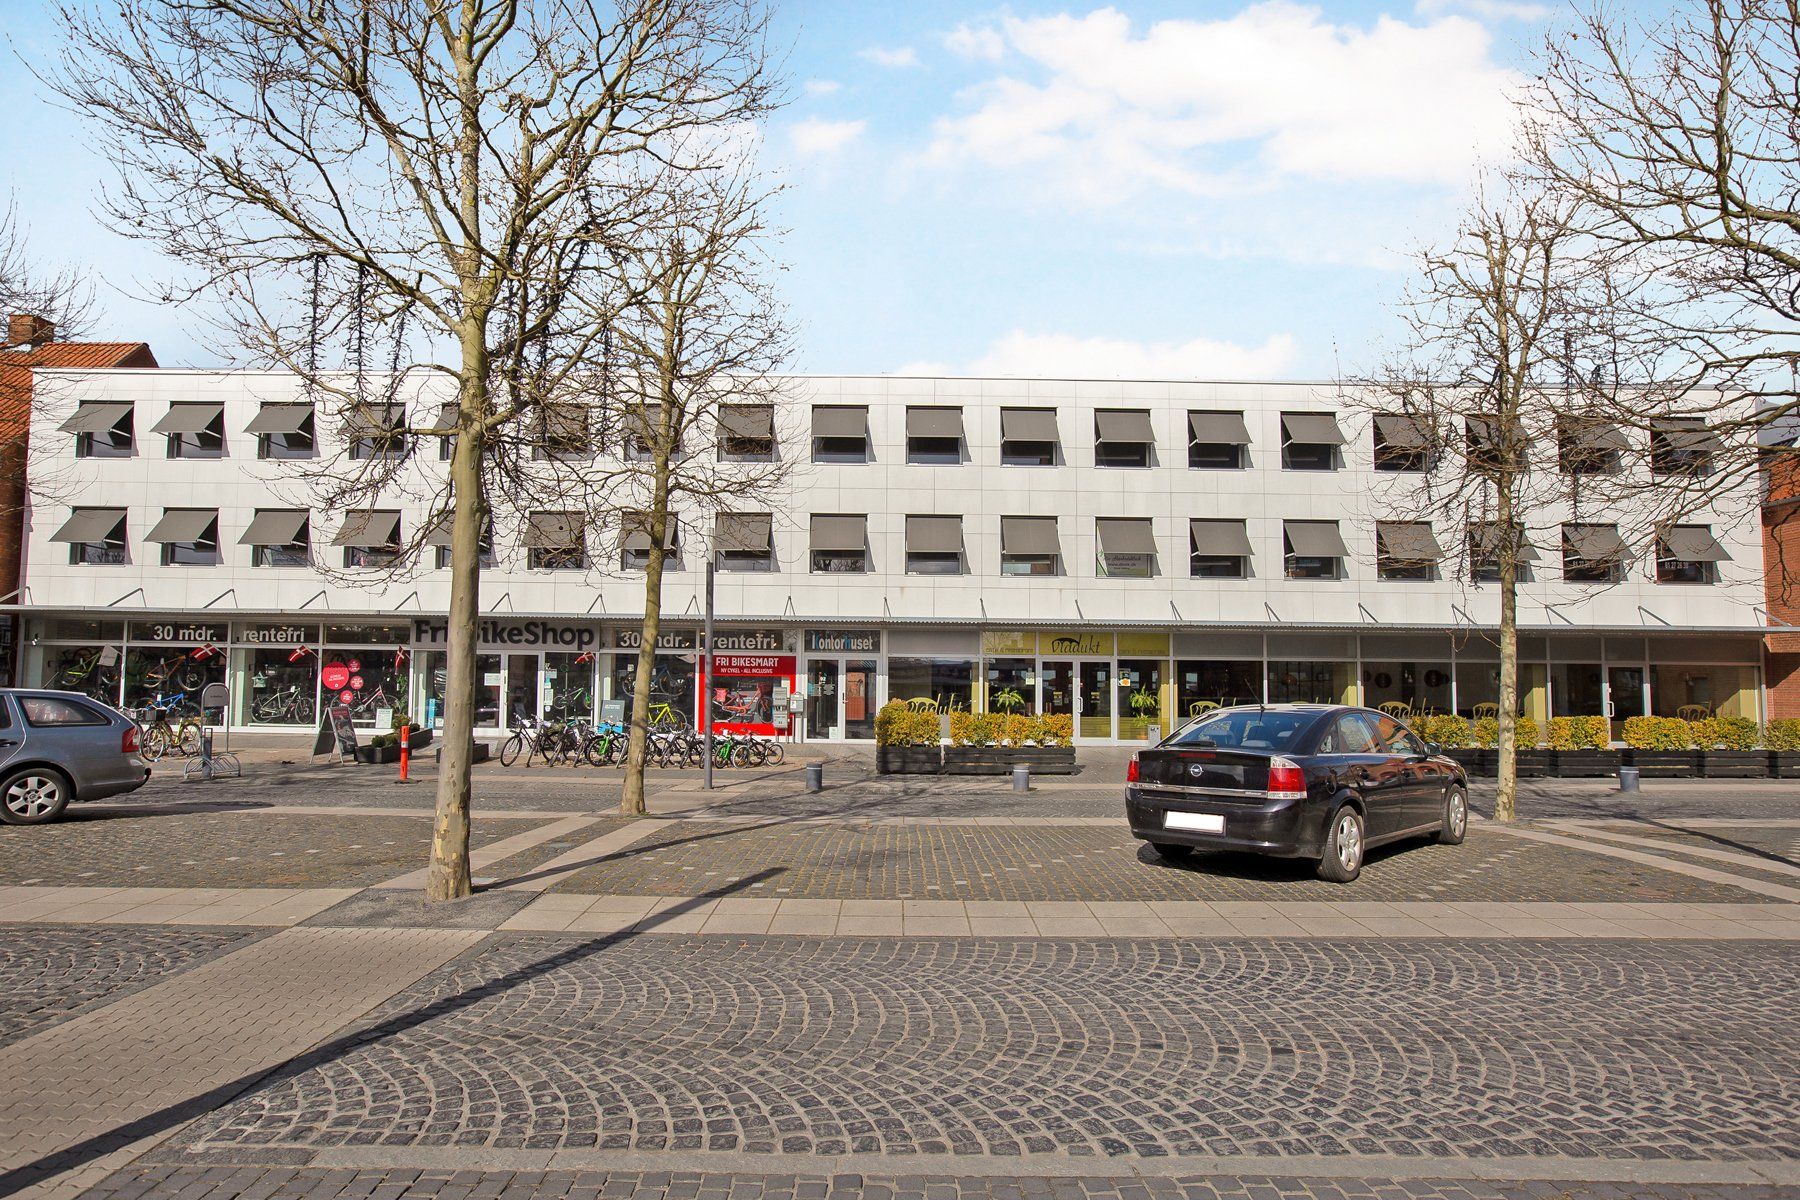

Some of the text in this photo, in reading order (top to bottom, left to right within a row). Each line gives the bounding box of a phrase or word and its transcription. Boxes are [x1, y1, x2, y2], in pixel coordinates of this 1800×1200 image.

[153, 625, 305, 642] 30 mdr. rentefri
[477, 621, 594, 651] ikeShop
[620, 632, 641, 647] 30
[713, 633, 775, 649] rentefri
[716, 657, 779, 667] FRI BIKESMART
